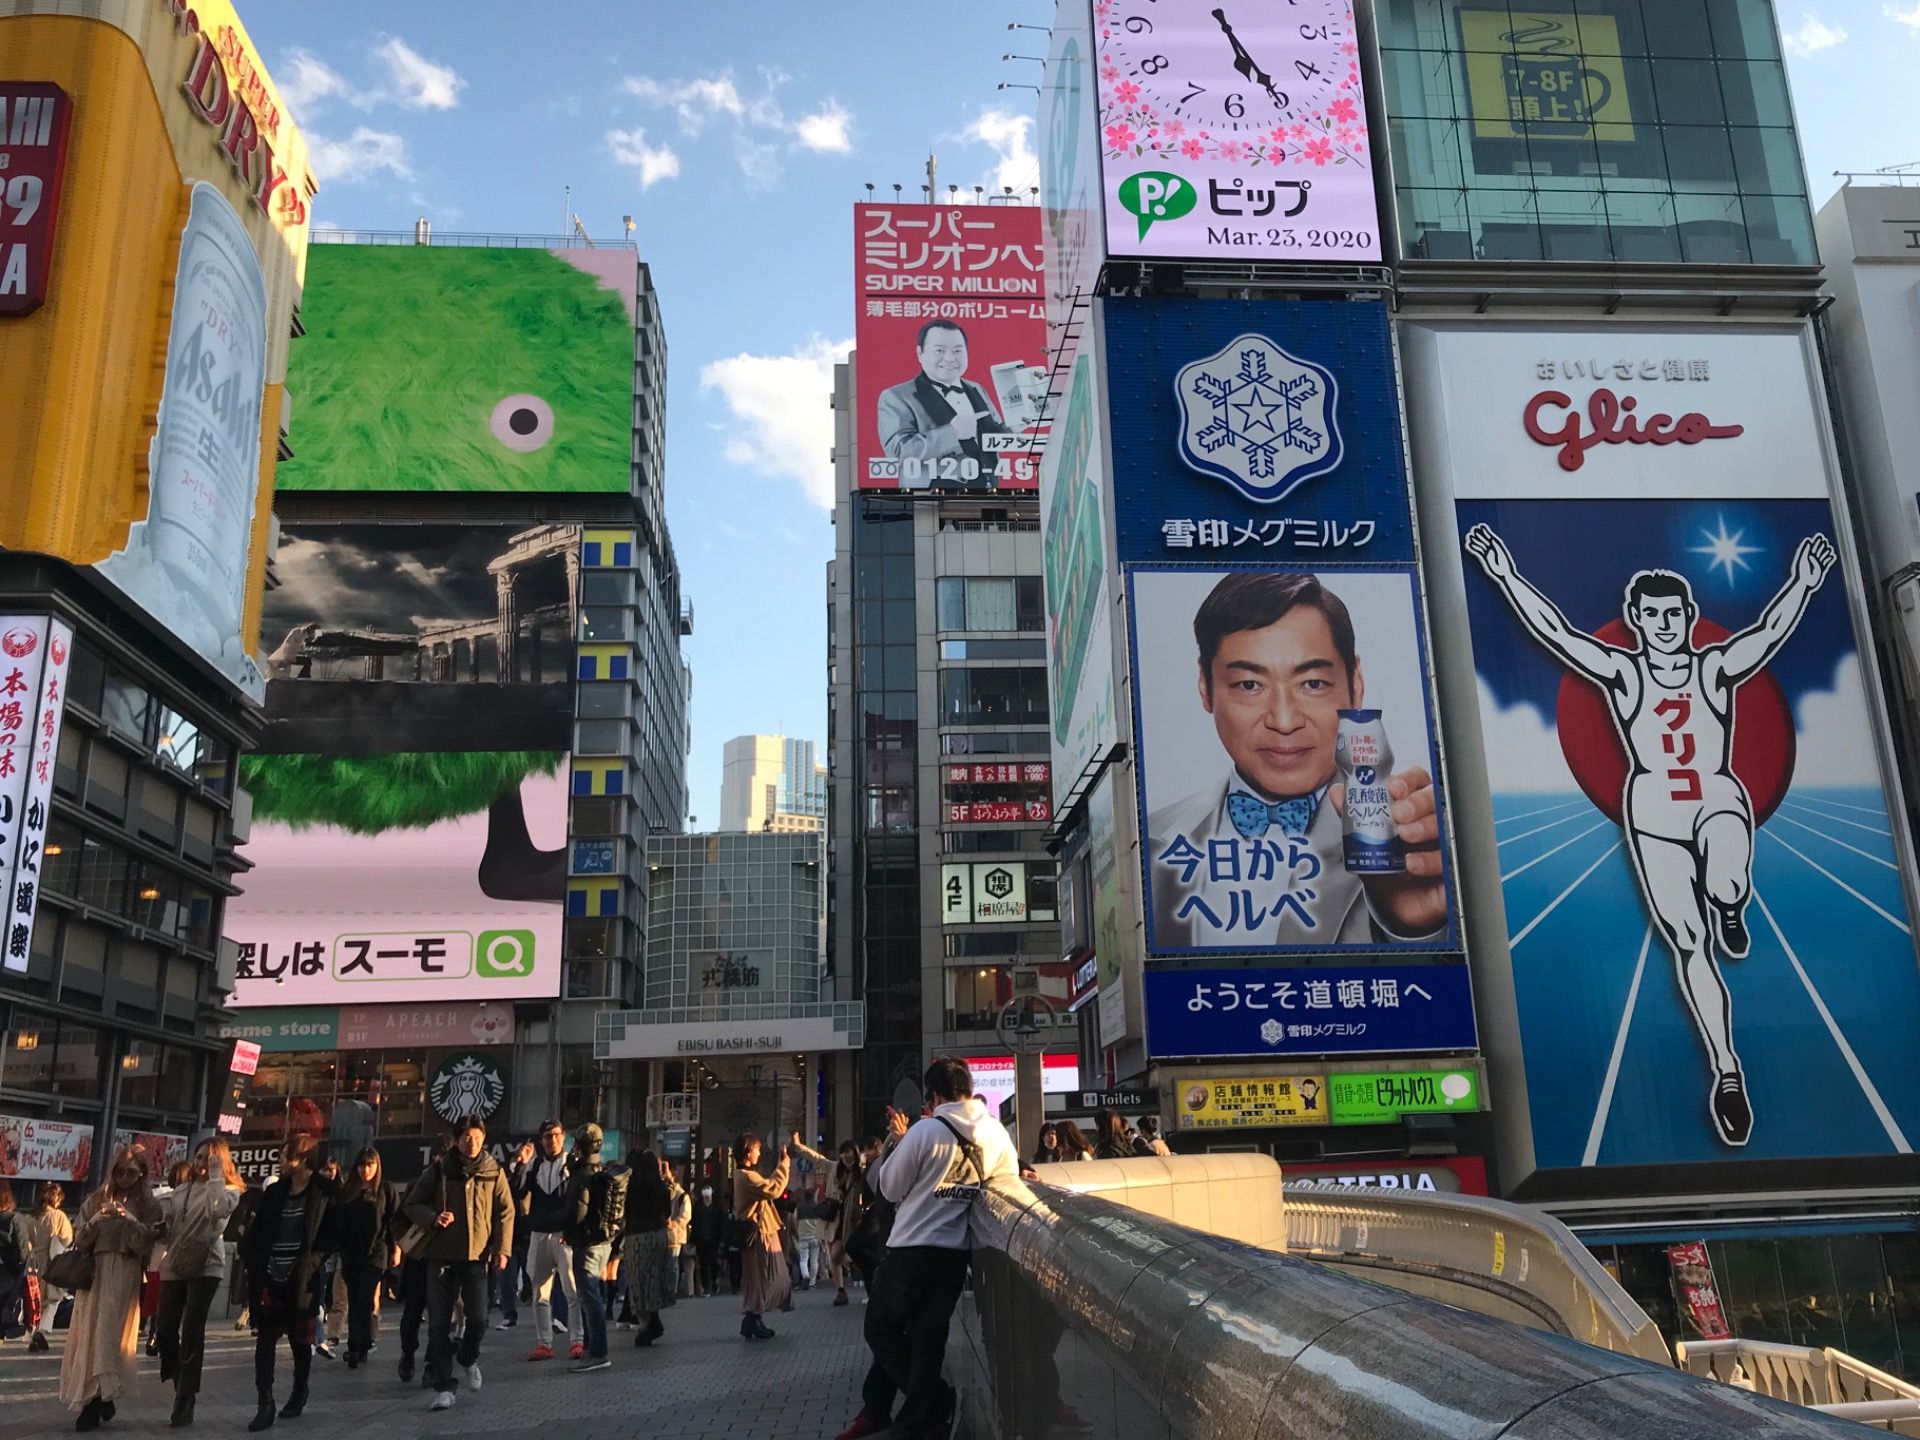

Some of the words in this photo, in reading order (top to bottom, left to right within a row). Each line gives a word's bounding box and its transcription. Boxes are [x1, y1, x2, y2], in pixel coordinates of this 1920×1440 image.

[1125, 16, 1153, 34] 9
[1300, 24, 1328, 41] 3
[1141, 54, 1169, 75] 8
[1294, 59, 1320, 81] 4
[223, 25, 281, 137] SUPER
[1180, 81, 1207, 104] 7
[1508, 68, 1575, 93] 7-8F
[1224, 93, 1245, 118] 6
[0, 175, 43, 226] 9
[1208, 178, 1312, 217] ピップ
[865, 210, 995, 239] スーパー
[1207, 227, 1262, 246] Mar.
[1267, 228, 1302, 249] 23,
[1307, 229, 1372, 248] 2020
[0, 243, 27, 295] A
[865, 275, 944, 291] SUPER
[952, 277, 1037, 293] MILLION
[1536, 357, 1711, 382] おいしさと健康
[172, 321, 252, 464] Asahi
[1524, 388, 1744, 472] Glico
[903, 457, 1039, 481] 0120-49
[1161, 518, 1375, 547] 雪印メグミルク
[1653, 692, 1703, 802] グリコ
[1348, 787, 1388, 804] 乳酸菌
[951, 805, 969, 820] 5F
[1159, 834, 1321, 883] 今日から
[1177, 889, 1316, 932] ヘルベ
[340, 938, 446, 976] スーモ
[1187, 979, 1433, 1012] ようこそ道頓堀へ
[220, 1024, 272, 1038] osme
[279, 1021, 331, 1036] store
[386, 1012, 457, 1029] APEACH
[1287, 1022, 1367, 1038] 雪印メグミルク
[677, 1040, 714, 1051] EBISU
[716, 1036, 782, 1050] BASHI-SUJI
[1100, 1093, 1141, 1105] Toilets
[1376, 1076, 1437, 1107] ピタットハウス
[231, 1148, 279, 1164] RBUC
